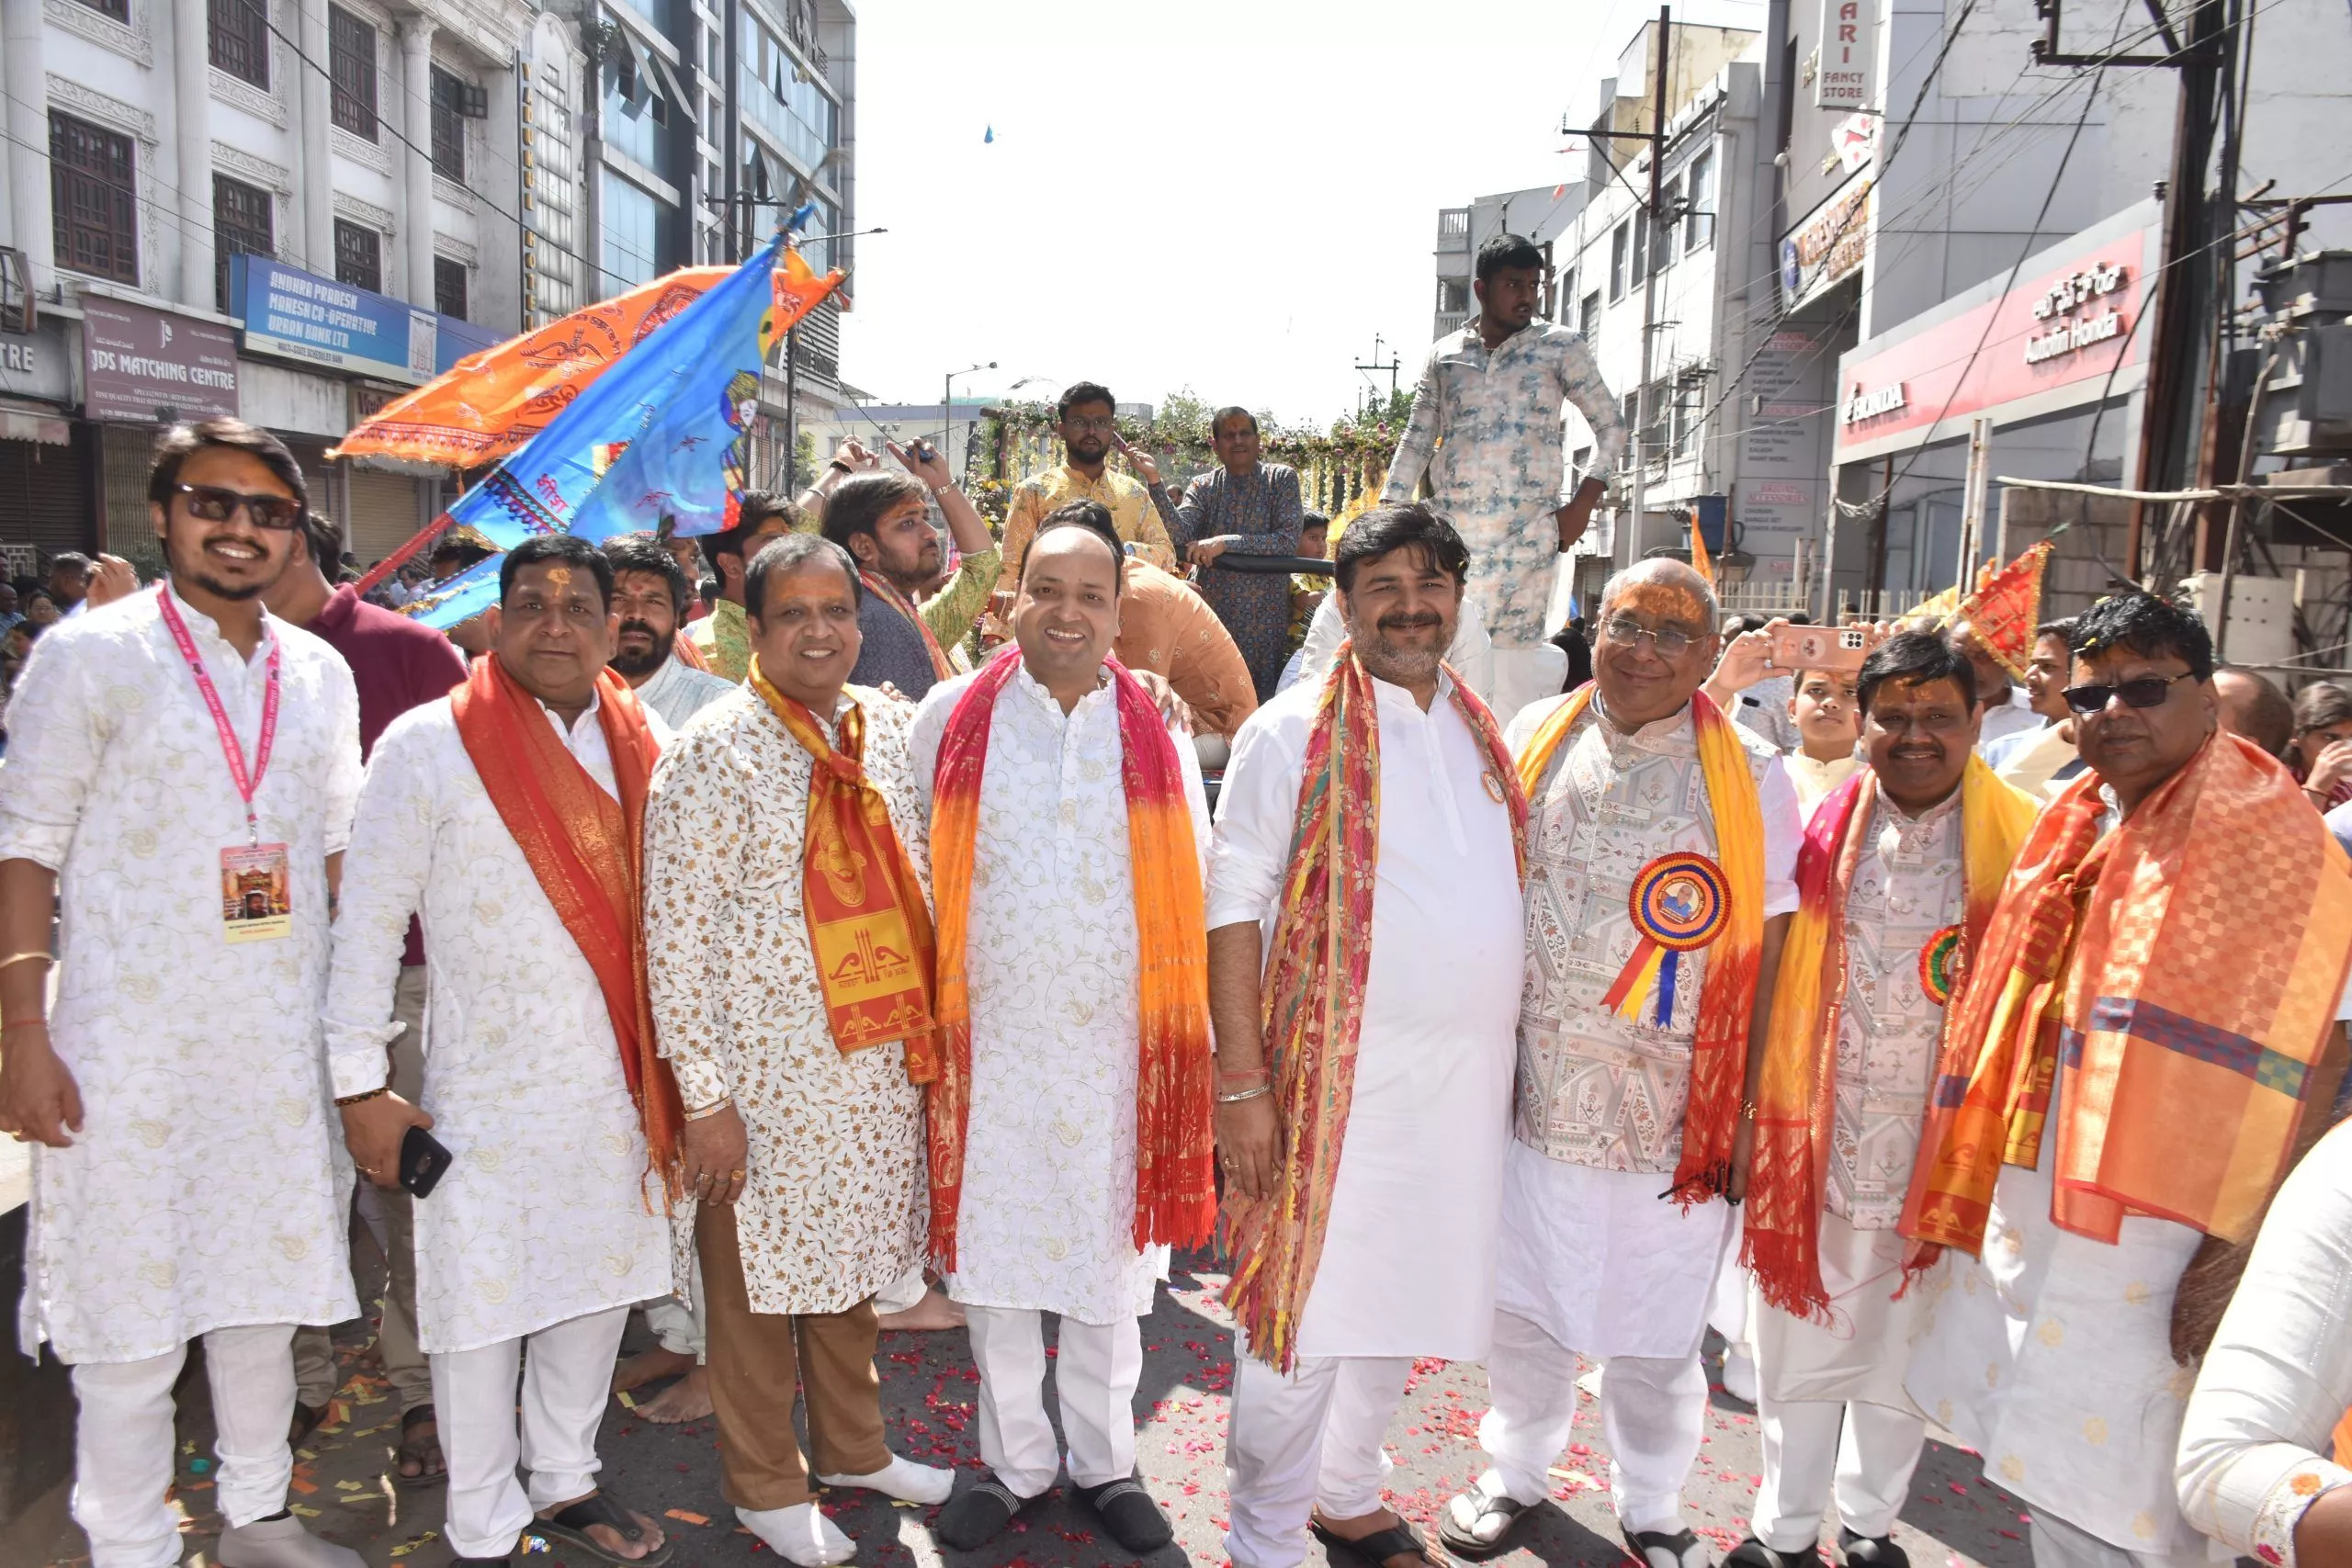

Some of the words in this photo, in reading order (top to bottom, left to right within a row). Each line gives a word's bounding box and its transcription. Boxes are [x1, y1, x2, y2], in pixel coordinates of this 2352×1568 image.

[1823, 86, 1863, 99] STORE
[1824, 72, 1864, 84] FANCY
[270, 271, 313, 299] ANDHRA
[313, 283, 357, 310] PRADESH
[267, 314, 304, 338] URBAN
[304, 323, 332, 345] BANK
[268, 292, 311, 319] MAHESH
[311, 304, 378, 336] CO-OPERATIVE
[2069, 308, 2118, 349] Honda
[91, 349, 117, 372] JDS
[119, 353, 187, 383] MATCHING
[190, 367, 235, 391] CENTRE
[1853, 382, 1904, 422] HONDA
